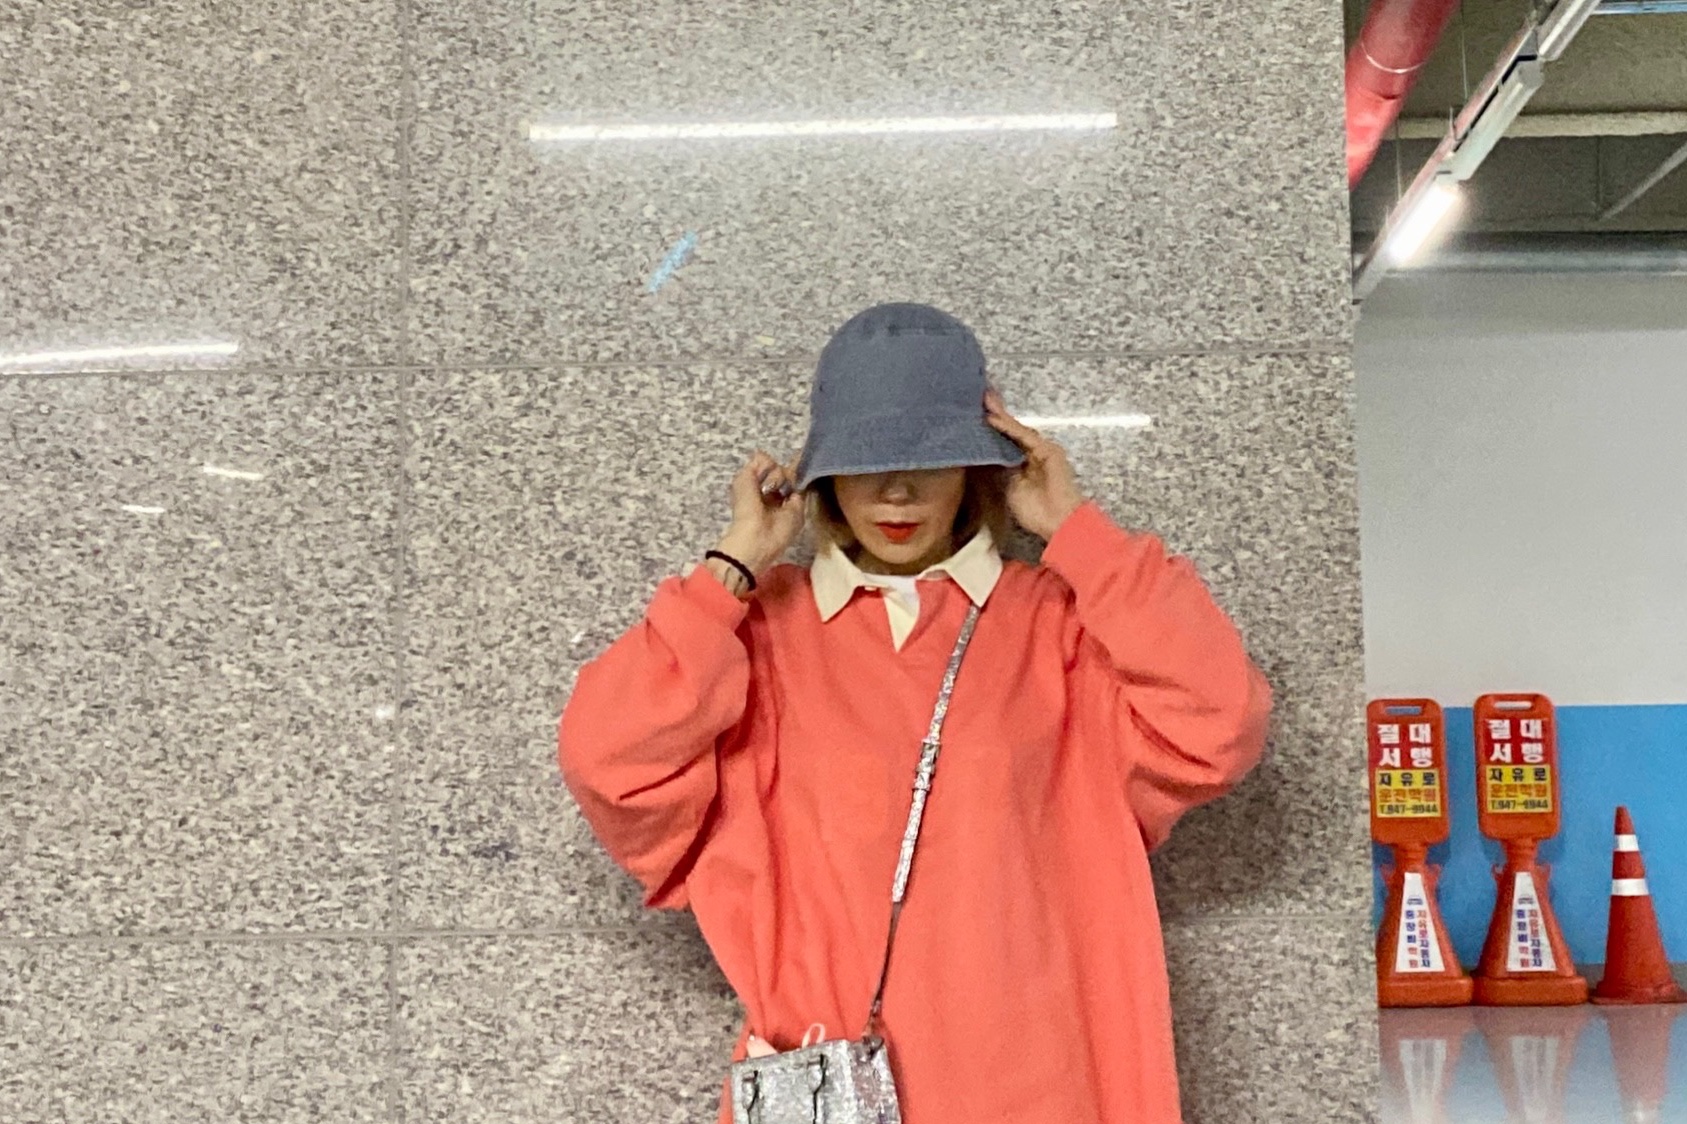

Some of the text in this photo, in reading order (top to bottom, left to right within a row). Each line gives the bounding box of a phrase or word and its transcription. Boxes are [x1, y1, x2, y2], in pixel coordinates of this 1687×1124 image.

[1377, 723, 1432, 745] 절대
[1488, 718, 1543, 740] 절대
[1379, 747, 1433, 768] 서행
[1489, 742, 1544, 763] 서행
[1379, 772, 1436, 787] 자유로
[1489, 767, 1547, 782] 자유로
